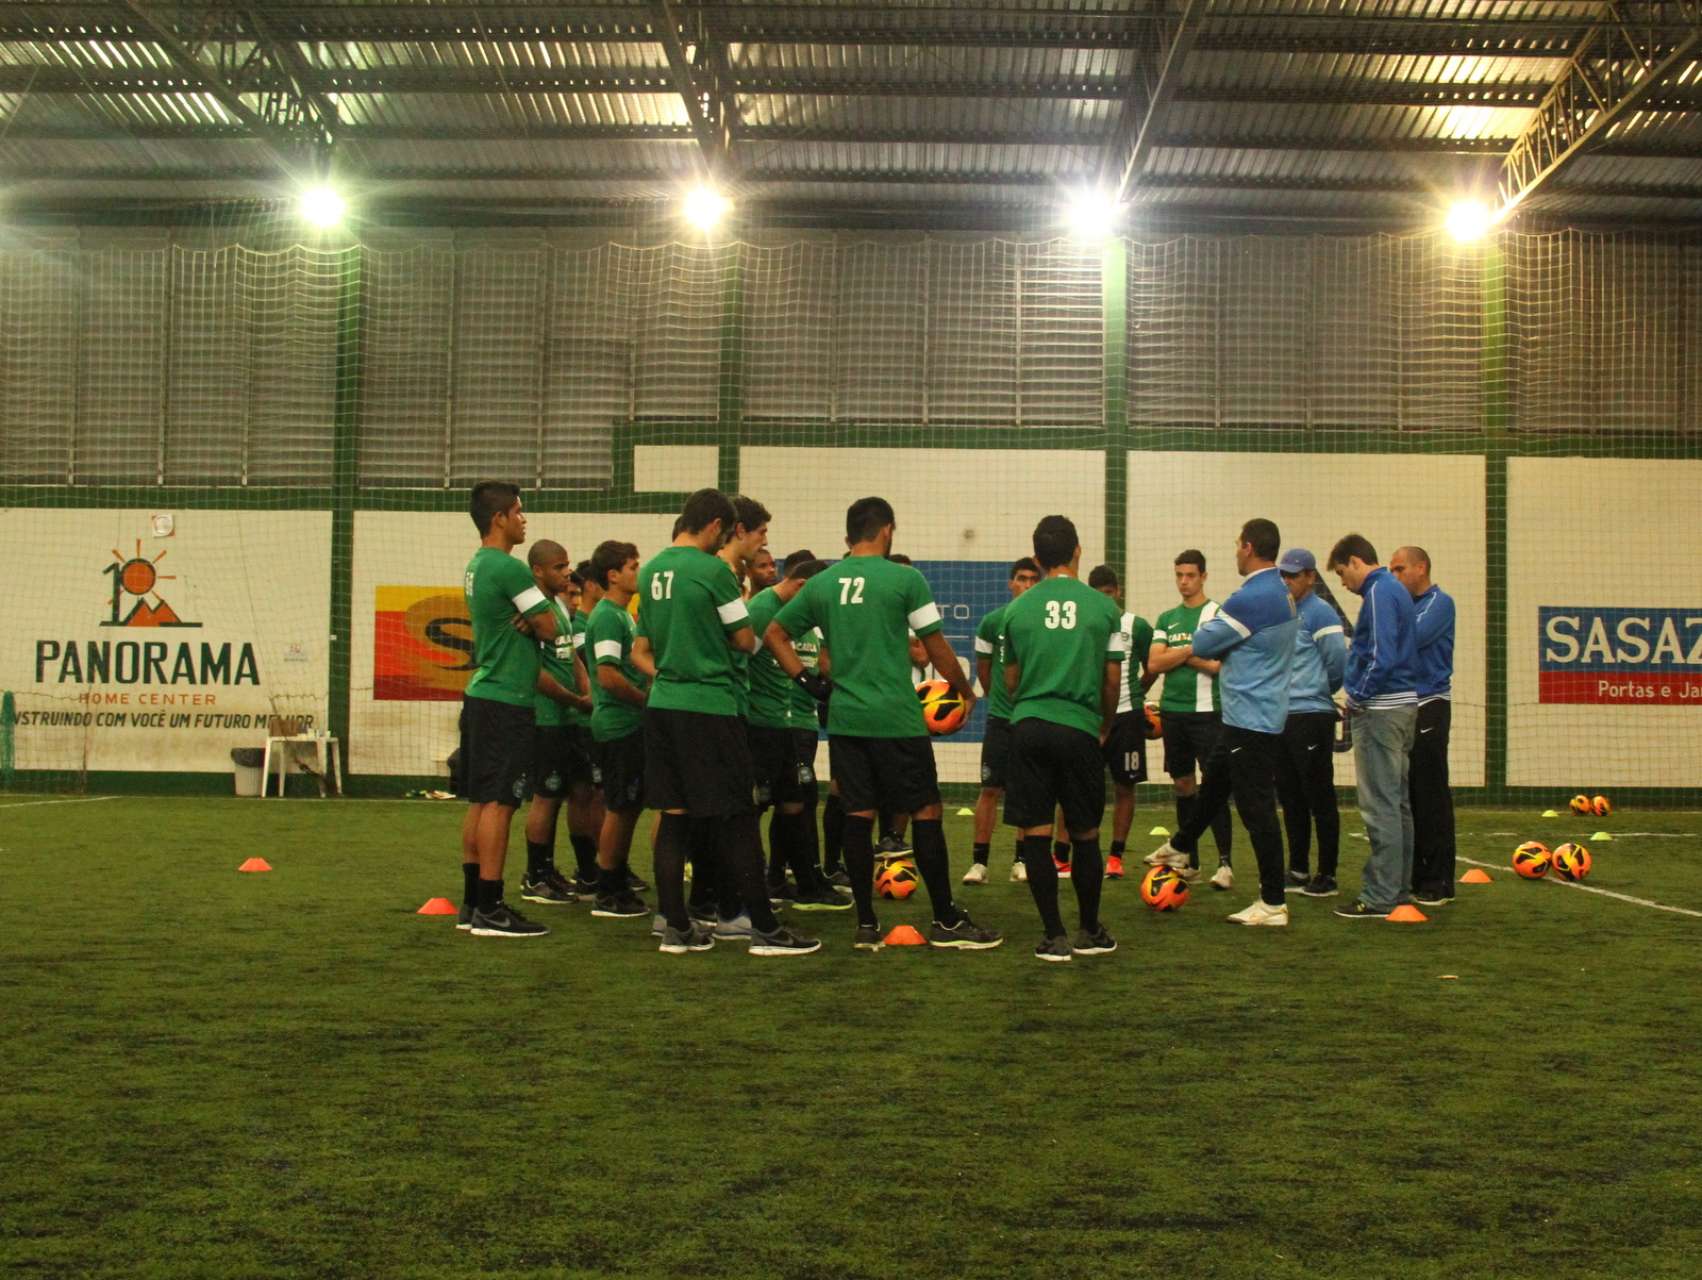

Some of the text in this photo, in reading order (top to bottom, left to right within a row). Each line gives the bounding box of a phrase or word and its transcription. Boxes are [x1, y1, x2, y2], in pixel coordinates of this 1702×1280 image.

[651, 571, 674, 600] 67
[838, 577, 865, 605] 72
[1045, 600, 1077, 629] 33
[35, 639, 260, 686] PANORAMA
[79, 692, 216, 706] HOME CENTER
[1598, 680, 1702, 698] Portas e Ja
[96, 712, 126, 727] COM
[131, 709, 166, 728] VOCÊ
[169, 713, 191, 728] UM
[194, 713, 252, 729] FUTURO
[1124, 751, 1140, 771] 18
